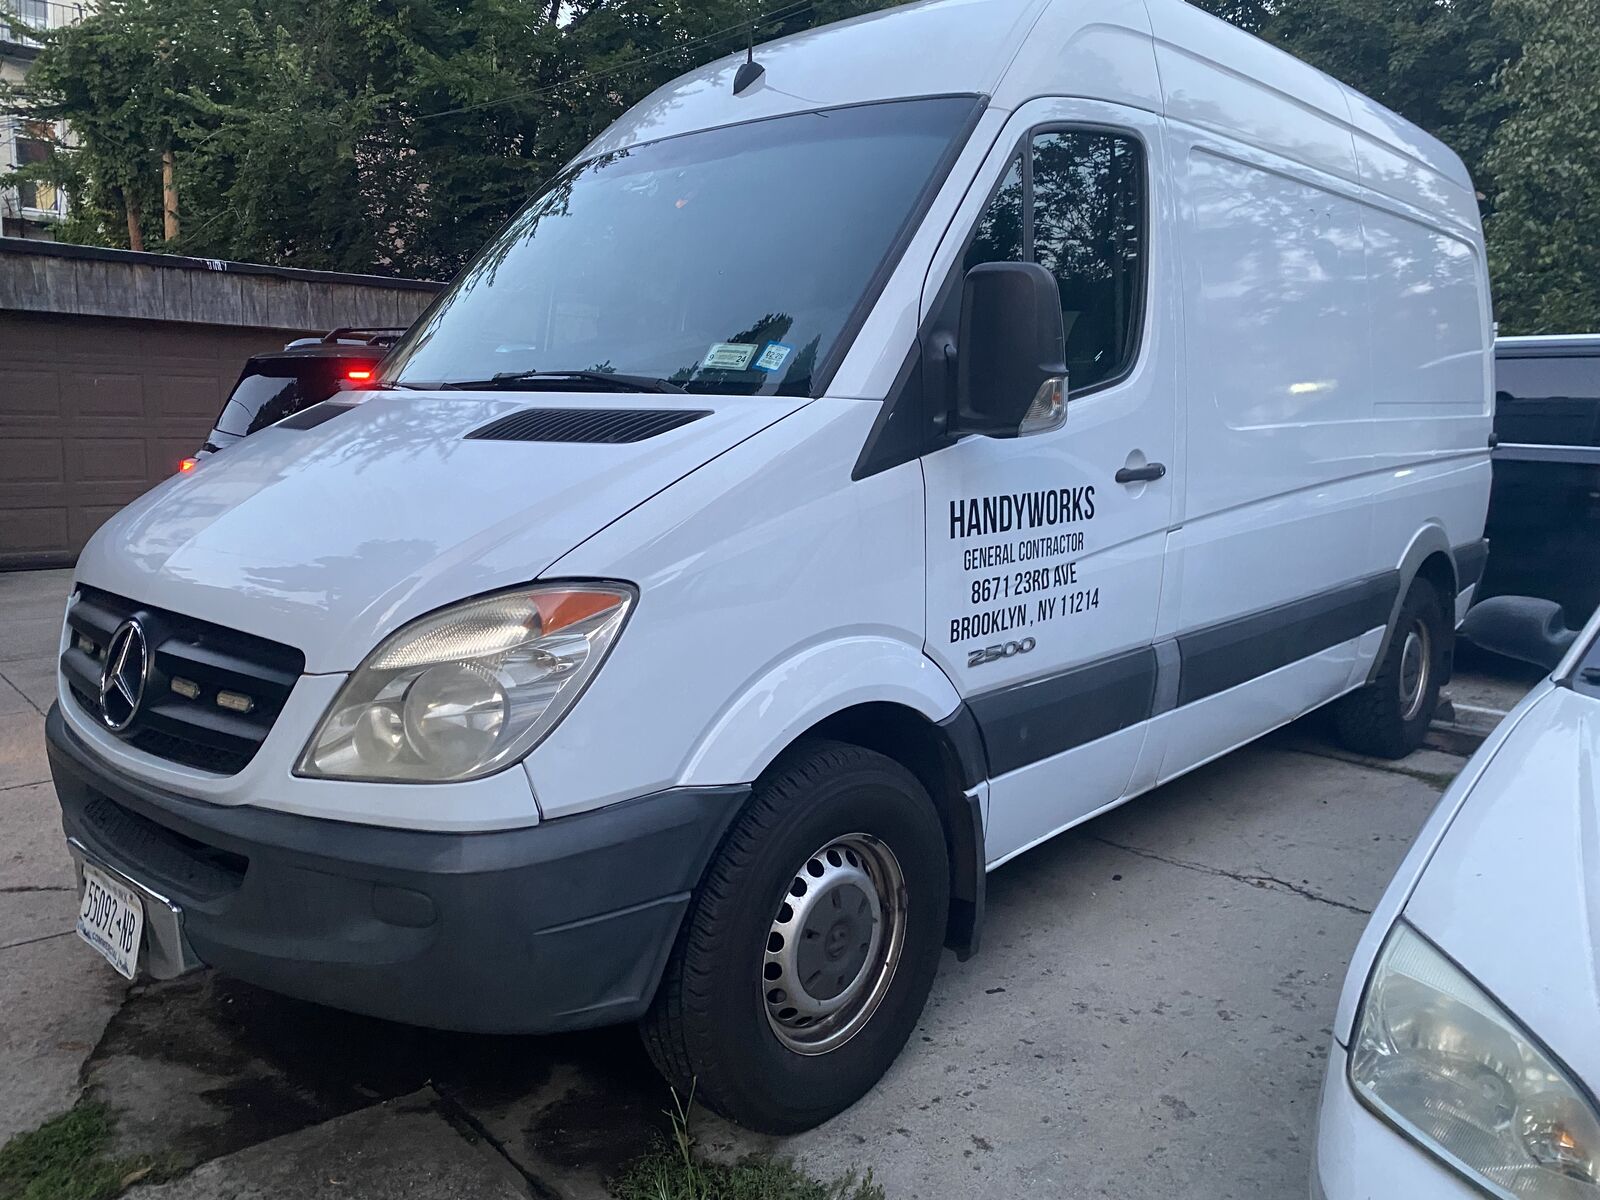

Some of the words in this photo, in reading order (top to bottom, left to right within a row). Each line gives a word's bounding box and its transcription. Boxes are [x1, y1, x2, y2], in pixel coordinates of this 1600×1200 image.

[735, 355, 748, 363] 24
[950, 486, 1095, 539] HANDYWORKS
[964, 543, 1016, 571] GENERAL
[1018, 532, 1084, 561] CONTRACTOR
[971, 575, 1009, 604] 8671
[1014, 568, 1050, 595] 23RD
[1053, 562, 1078, 587] AVE
[950, 604, 1027, 643] BROOKLYN
[1037, 597, 1056, 622] NY
[1061, 588, 1099, 616] 11214
[967, 637, 1036, 668] 2500
